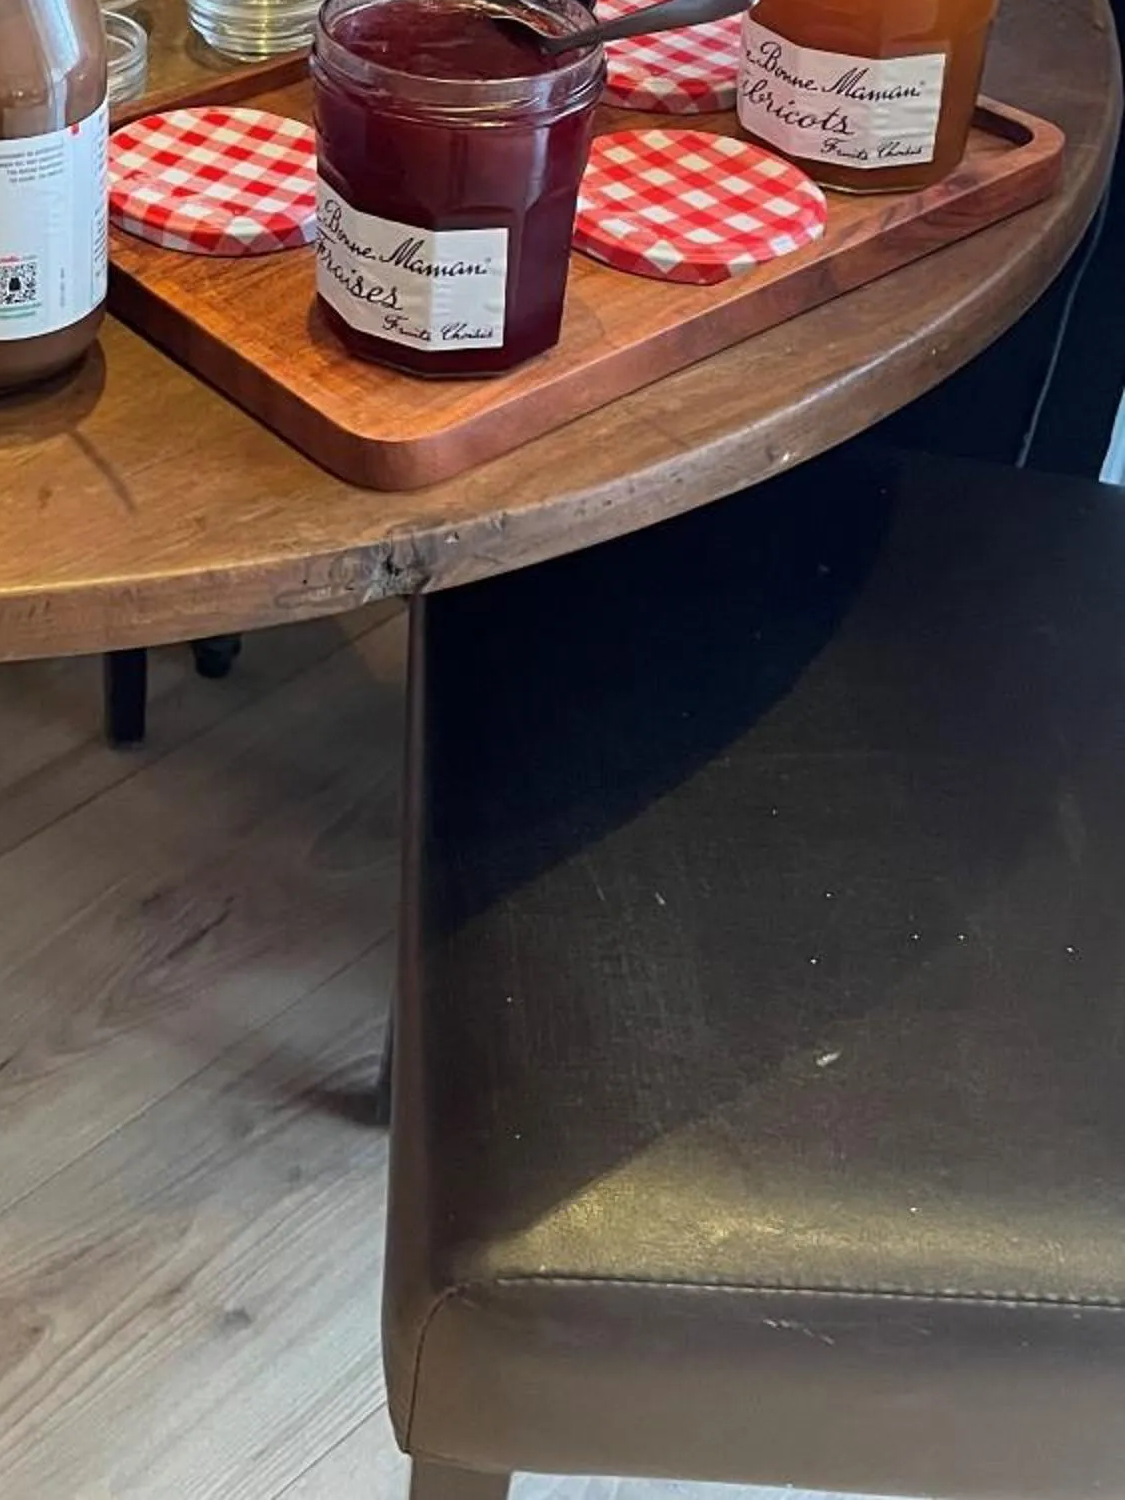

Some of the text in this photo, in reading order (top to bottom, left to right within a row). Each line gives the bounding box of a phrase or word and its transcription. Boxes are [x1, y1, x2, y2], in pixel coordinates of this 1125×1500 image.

[746, 40, 922, 103] Bonne Maman
[316, 199, 488, 278] Bonne Maman
